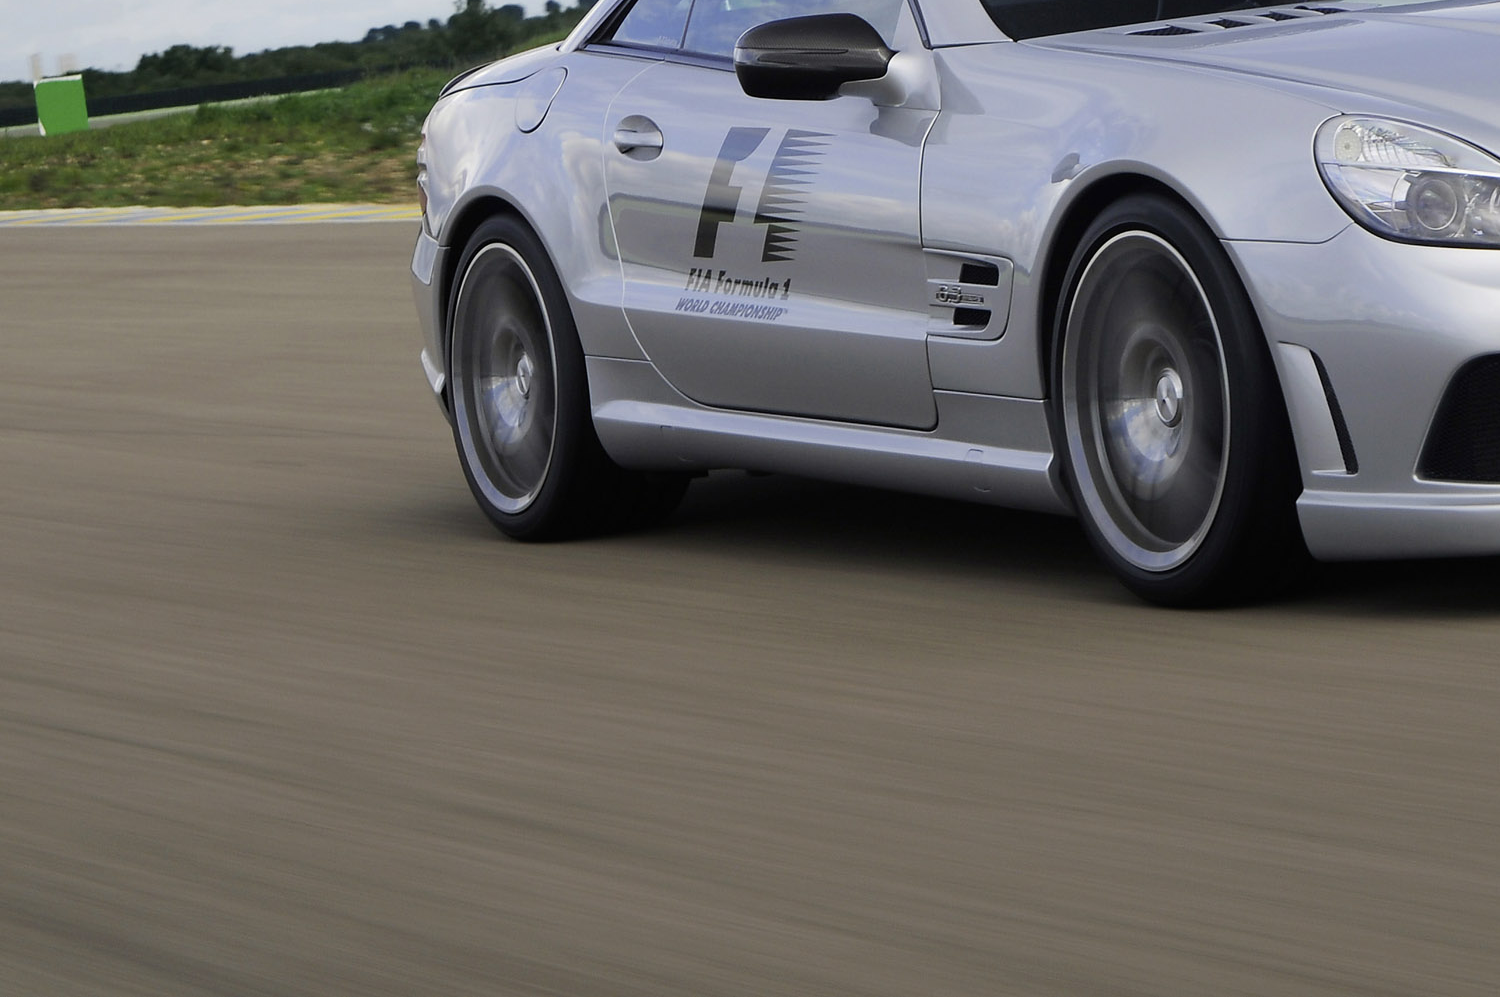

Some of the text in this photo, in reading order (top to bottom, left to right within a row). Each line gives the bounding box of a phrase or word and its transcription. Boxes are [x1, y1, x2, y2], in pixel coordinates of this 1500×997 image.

[684, 267, 792, 301] FIA Formula 1
[675, 297, 710, 313] WORLD
